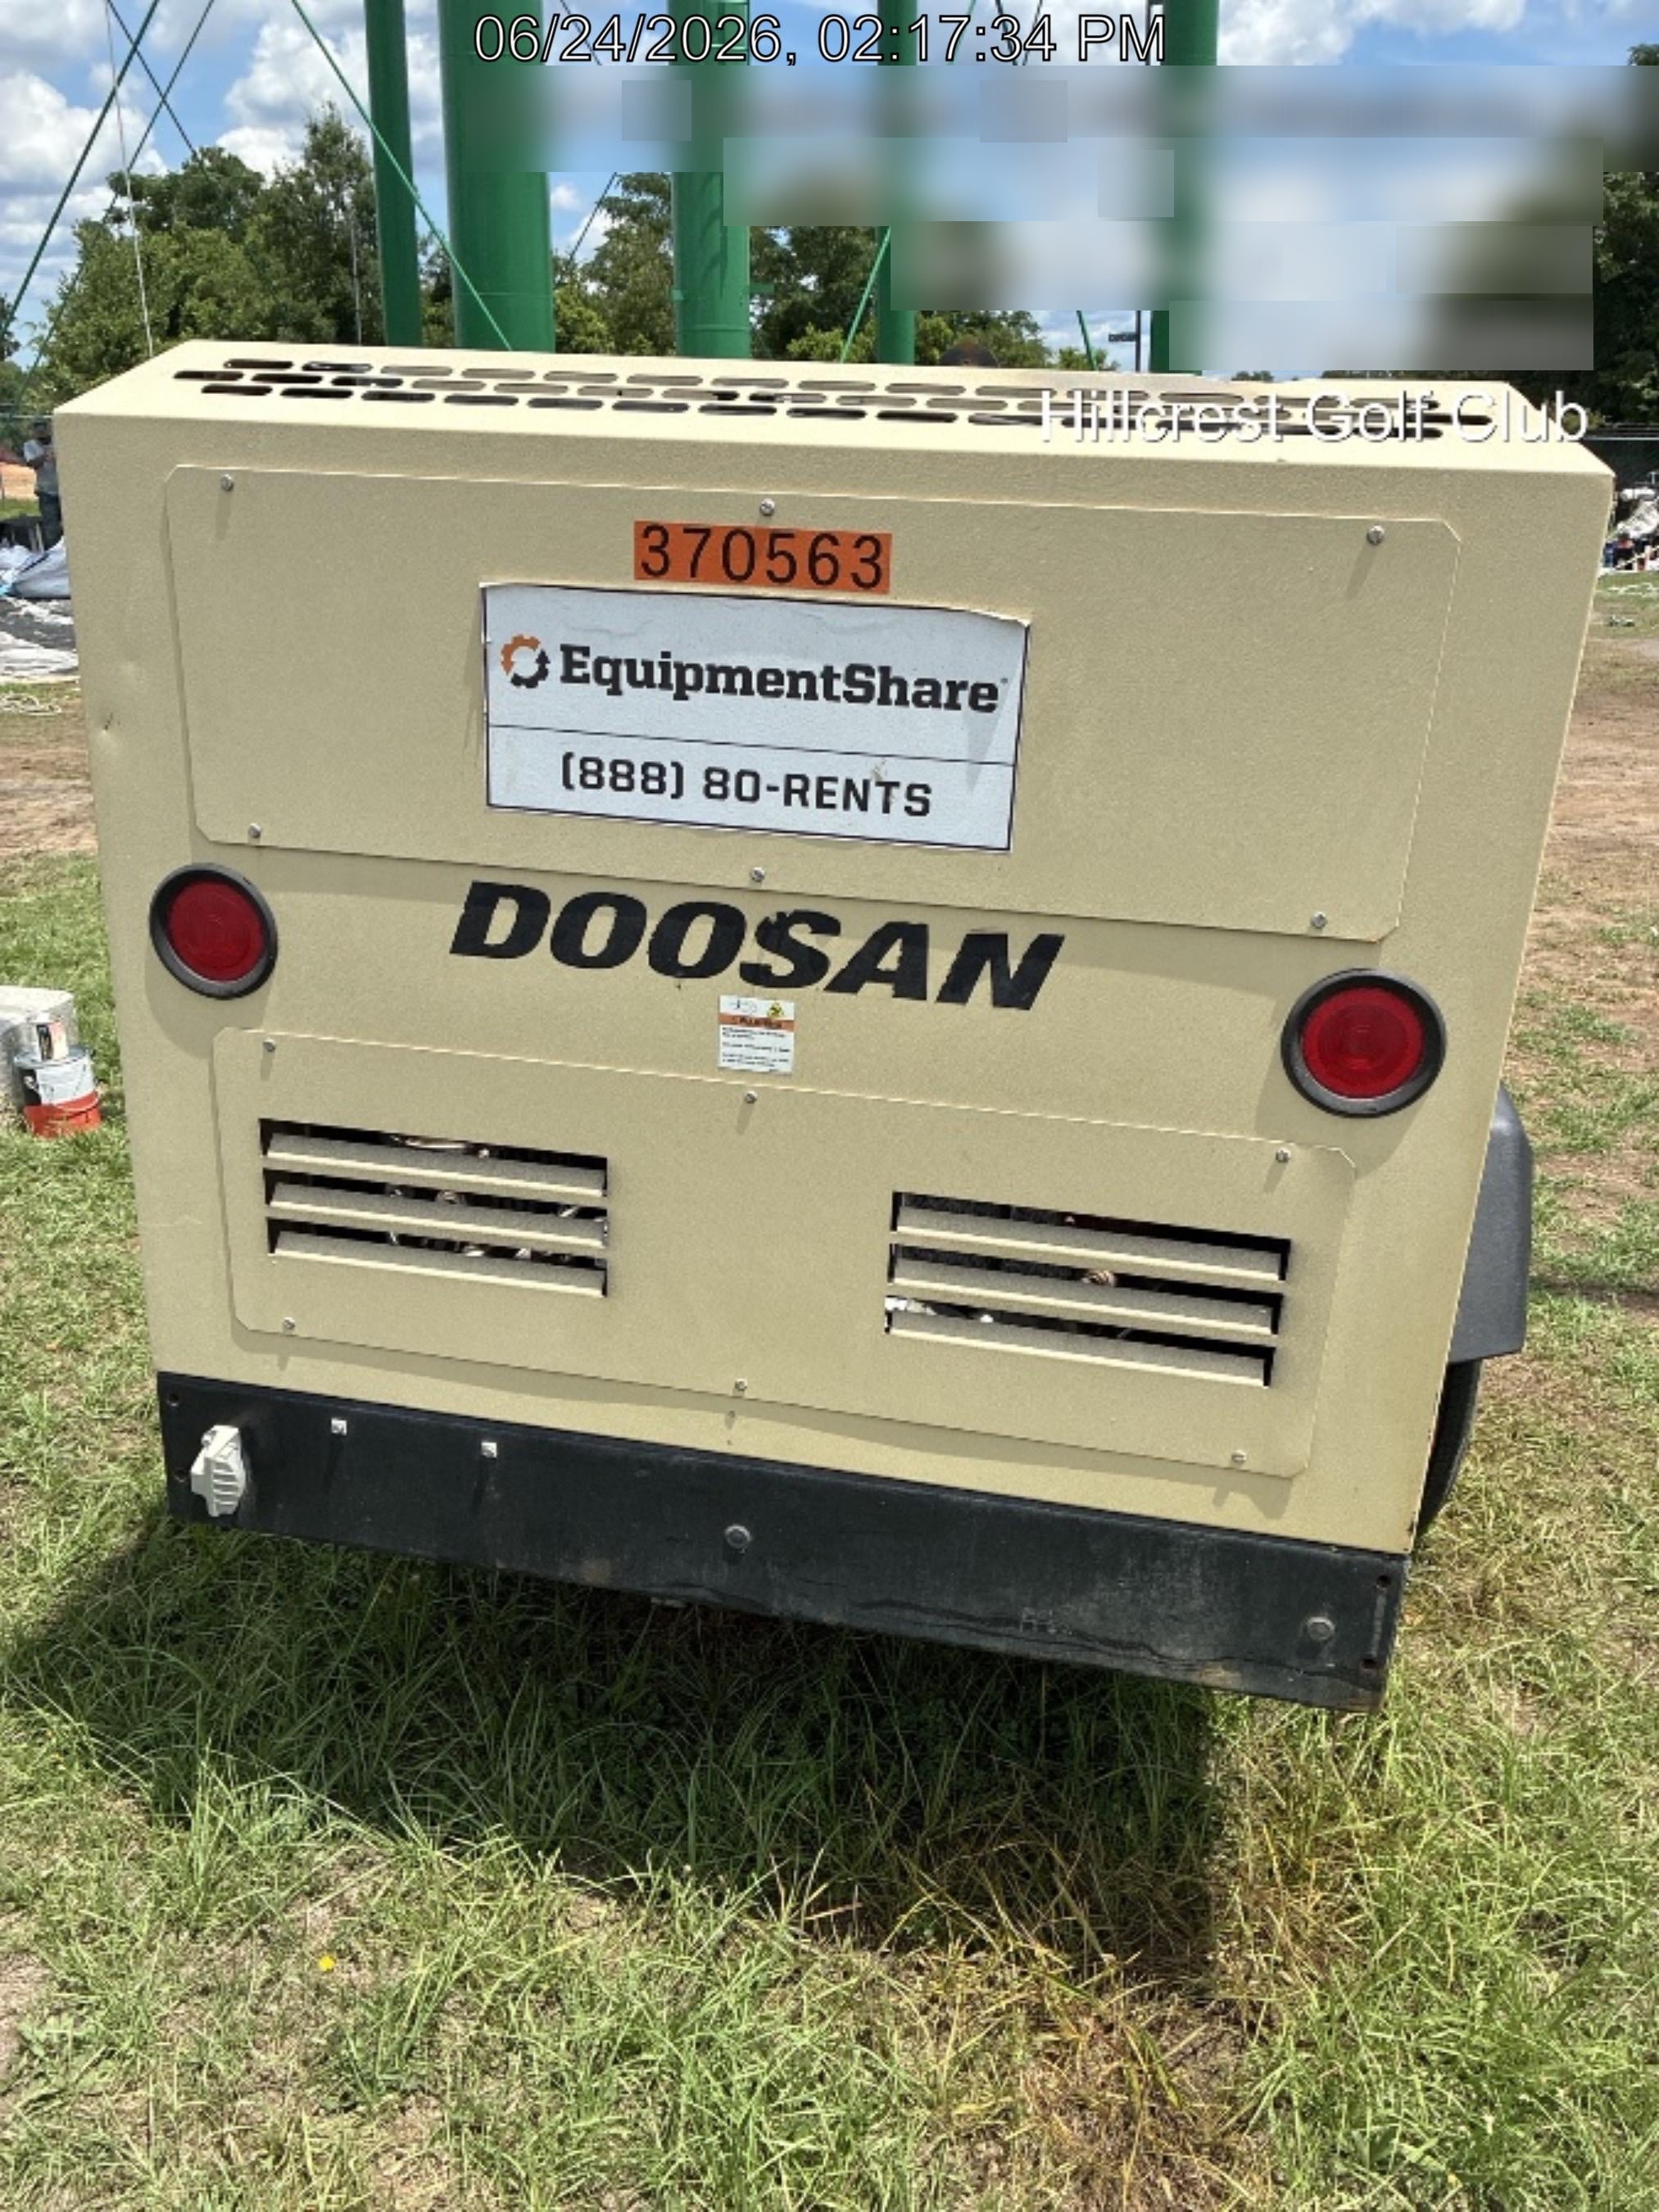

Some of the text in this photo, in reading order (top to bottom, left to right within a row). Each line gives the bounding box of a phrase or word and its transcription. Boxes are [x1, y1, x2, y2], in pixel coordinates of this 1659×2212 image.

[641, 524, 886, 589] 370563
[560, 751, 931, 818] (888) 80-RENTS
[449, 880, 1063, 1010] DOOSAN
